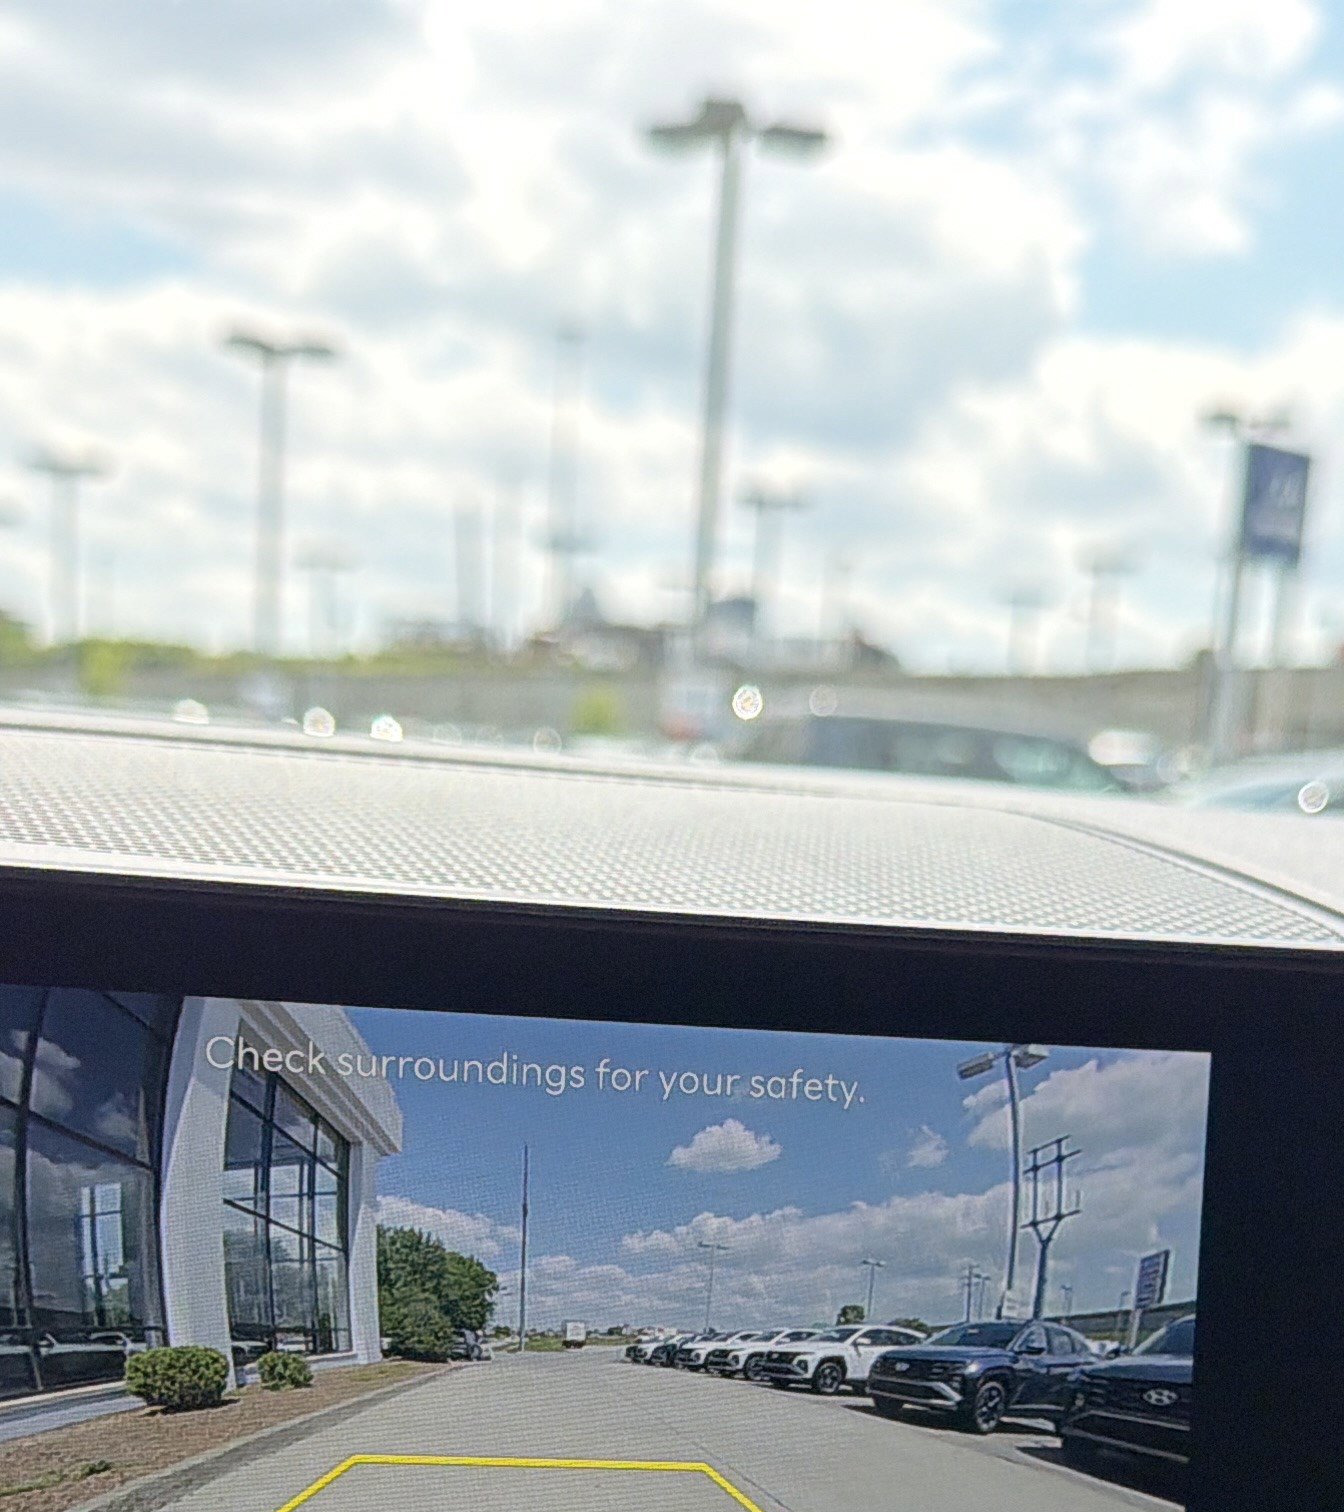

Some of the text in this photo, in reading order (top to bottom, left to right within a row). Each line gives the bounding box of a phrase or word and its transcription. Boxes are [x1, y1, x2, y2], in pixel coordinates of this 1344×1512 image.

[204, 1034, 867, 1109] Check surroundings for your safety.
